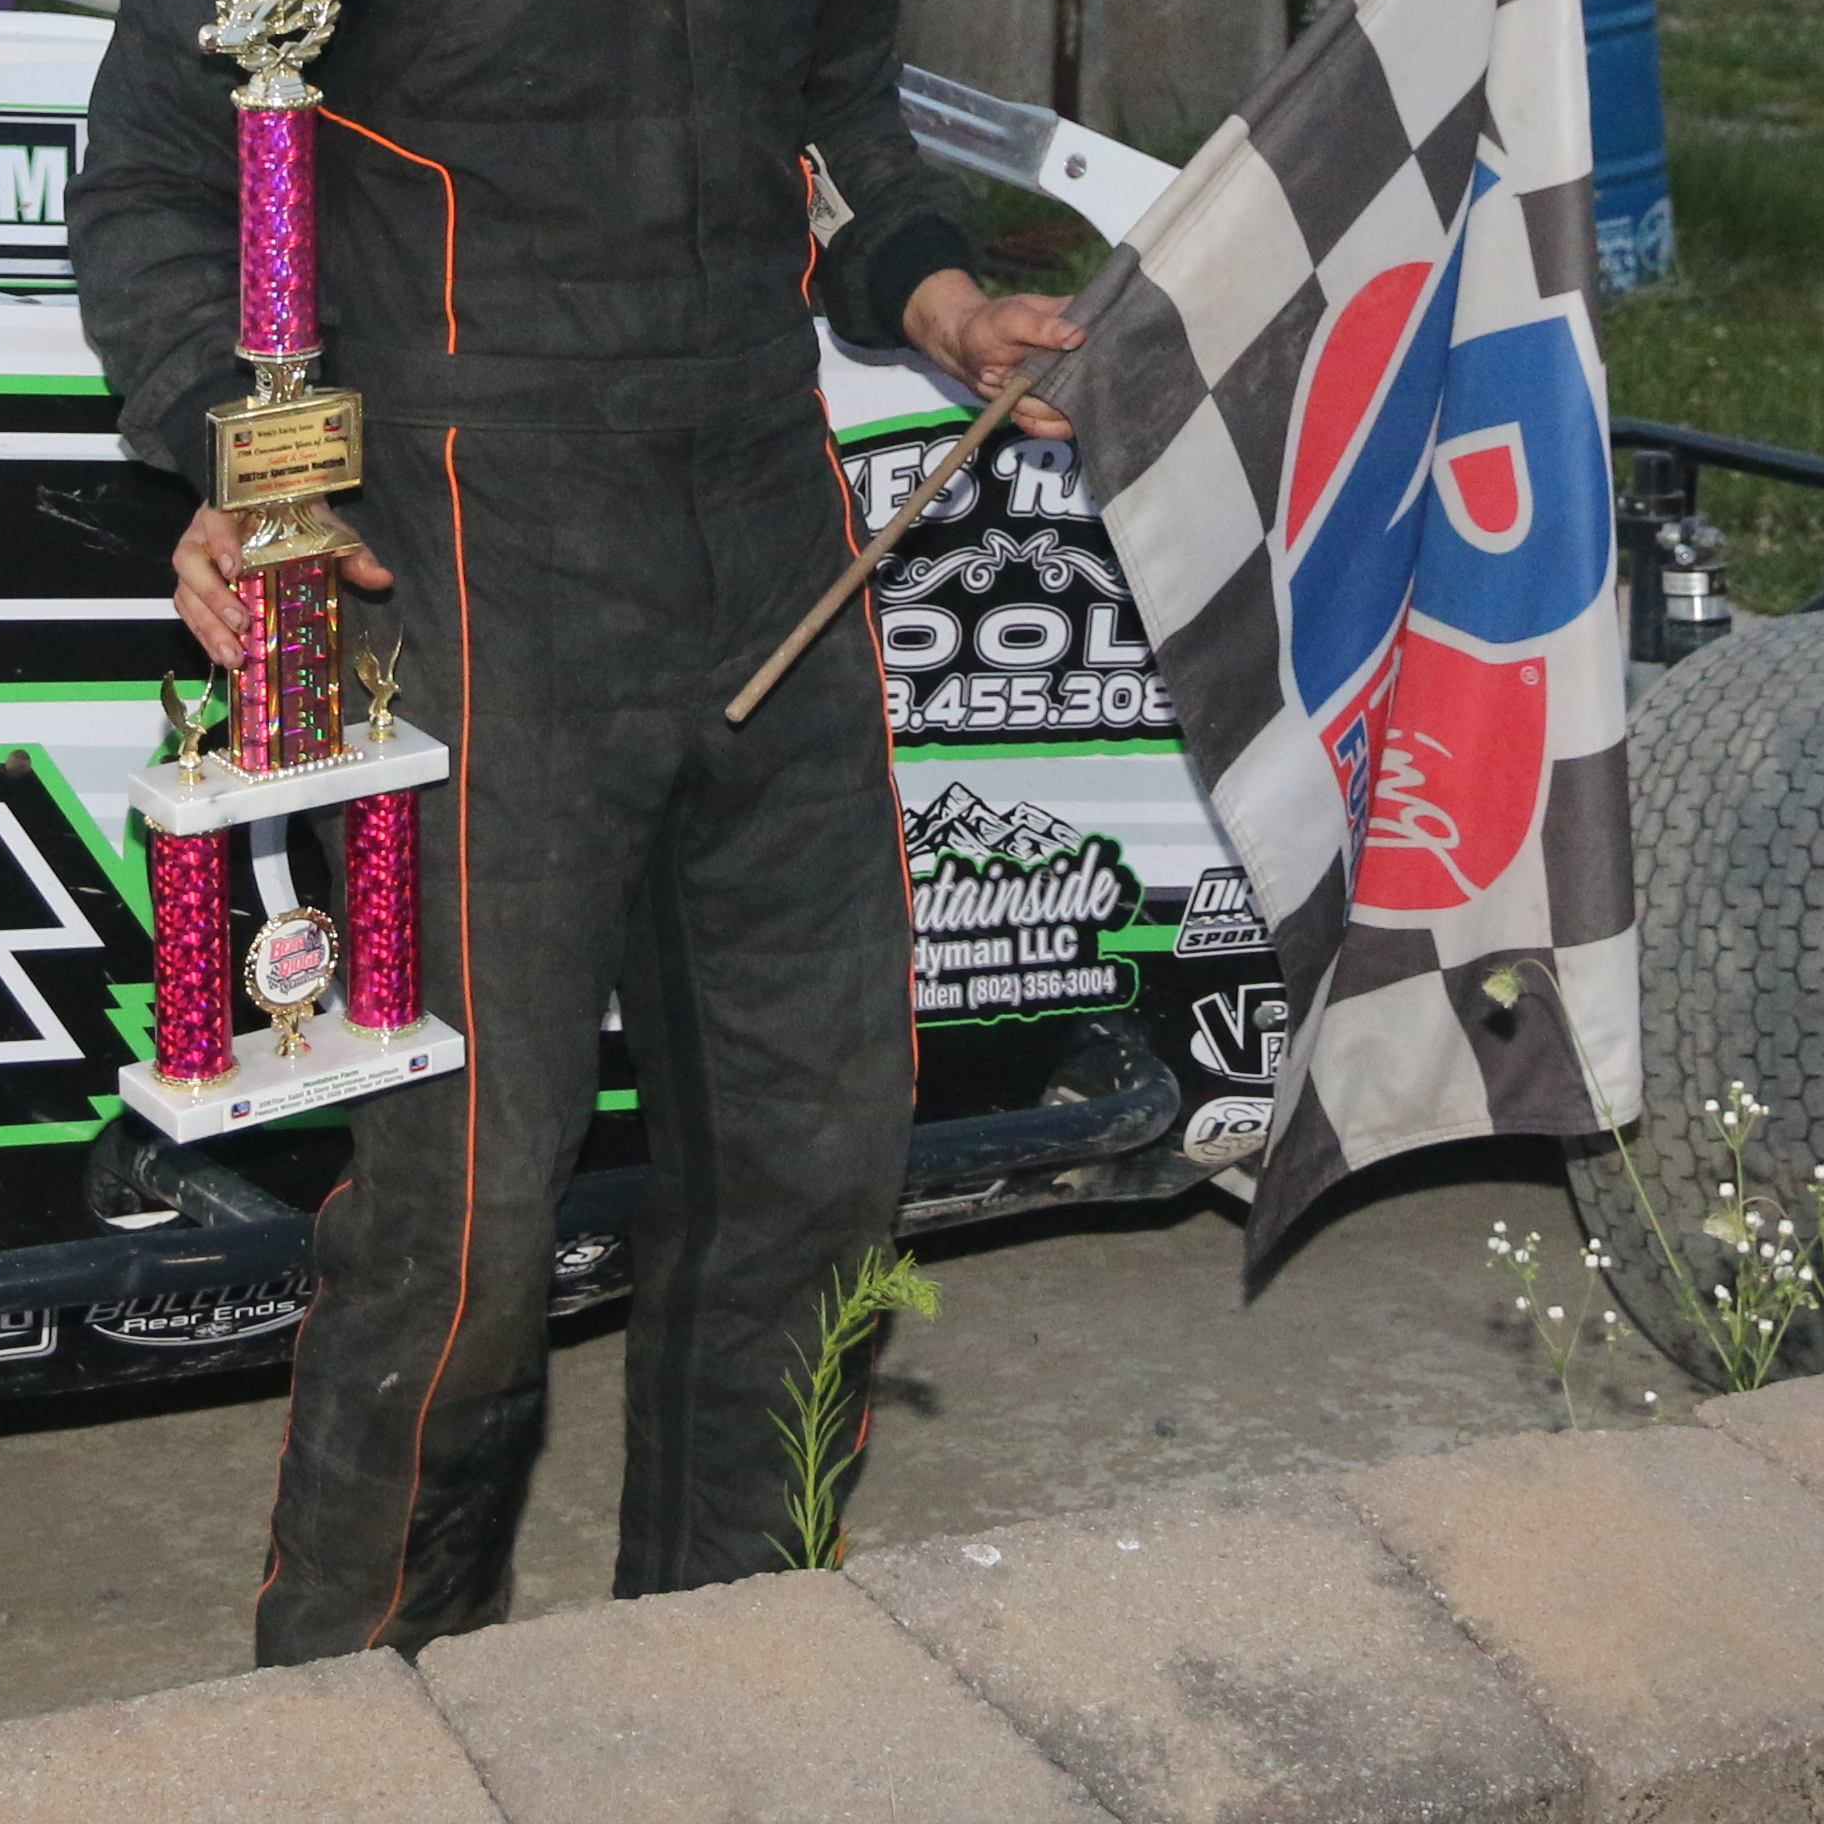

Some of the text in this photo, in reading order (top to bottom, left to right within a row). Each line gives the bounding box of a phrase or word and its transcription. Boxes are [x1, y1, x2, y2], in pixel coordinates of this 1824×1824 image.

[1018, 925, 1079, 965] LLC
[966, 975, 1022, 1010] (802)
[1023, 965, 1117, 1001] 356-3004
[122, 1299, 297, 1333] Rear Ends
